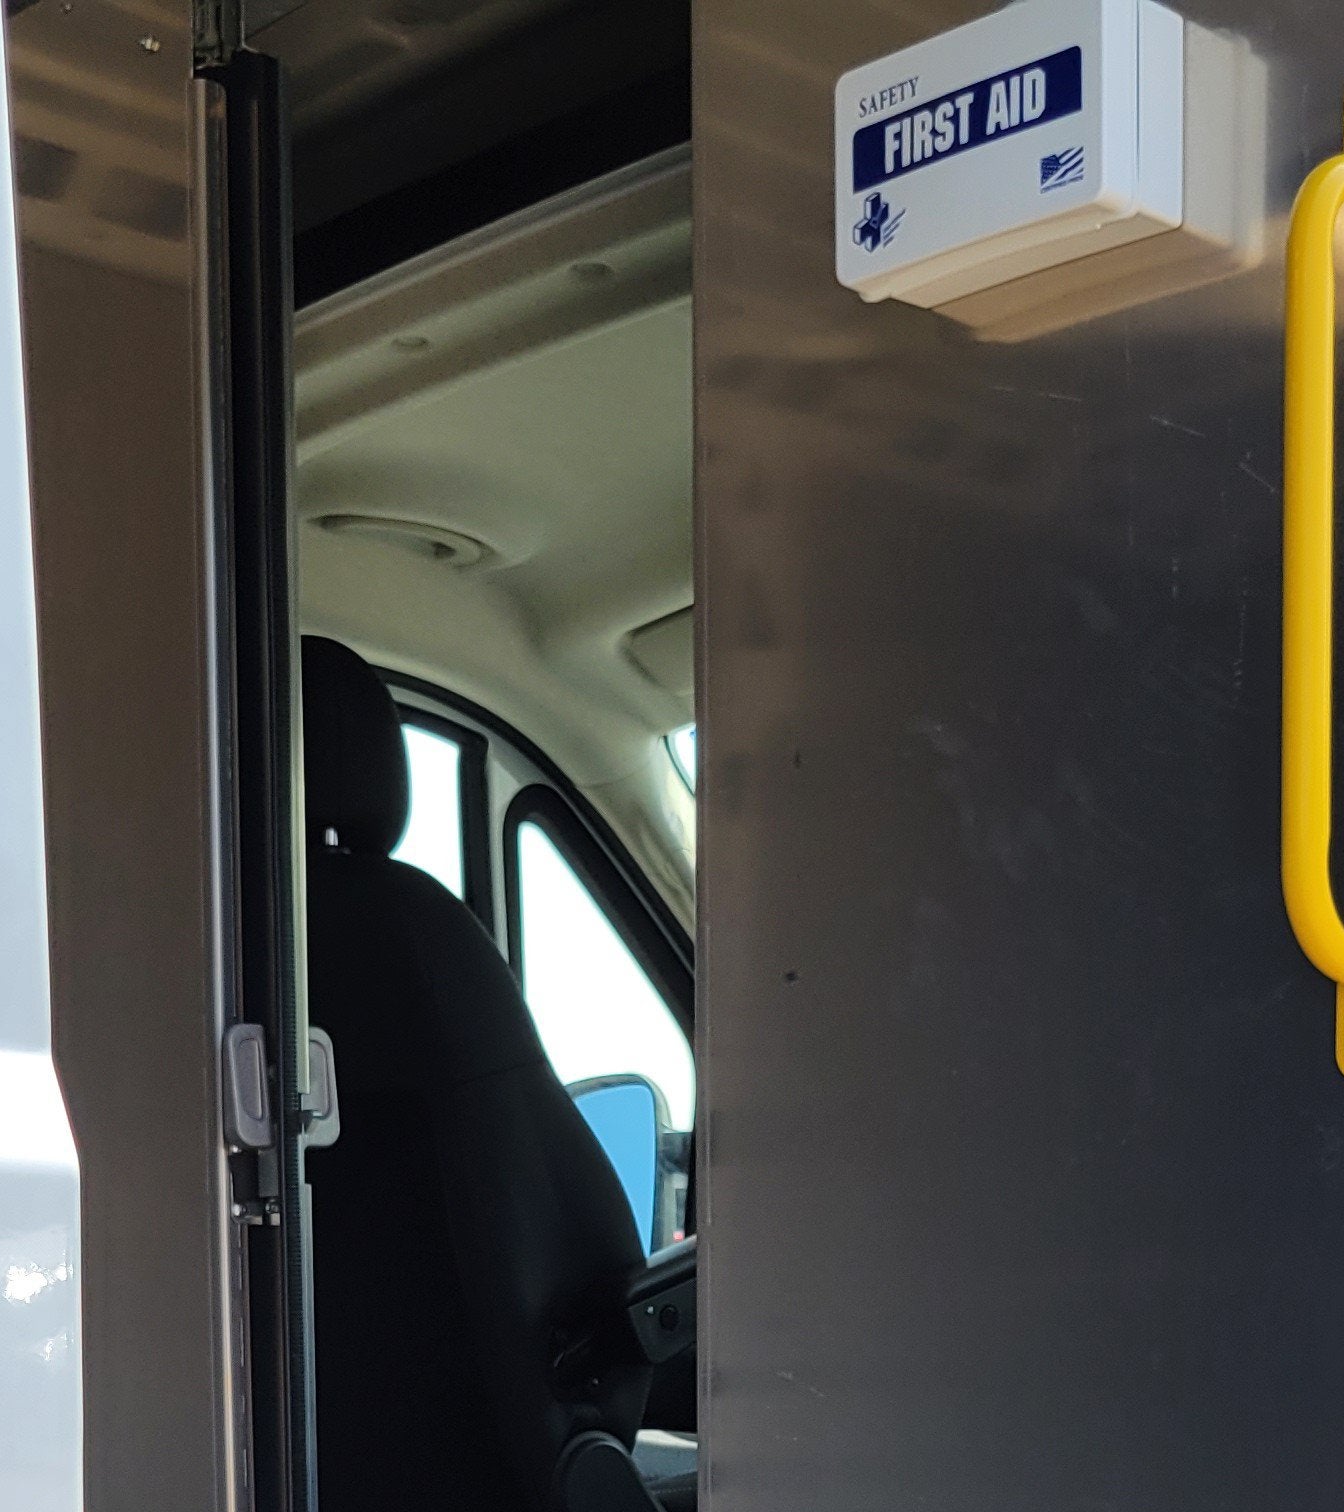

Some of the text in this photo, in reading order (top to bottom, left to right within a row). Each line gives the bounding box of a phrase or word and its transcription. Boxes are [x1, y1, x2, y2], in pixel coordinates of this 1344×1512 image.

[859, 75, 919, 118] SAFETY
[884, 67, 1046, 174] FIRST AID
